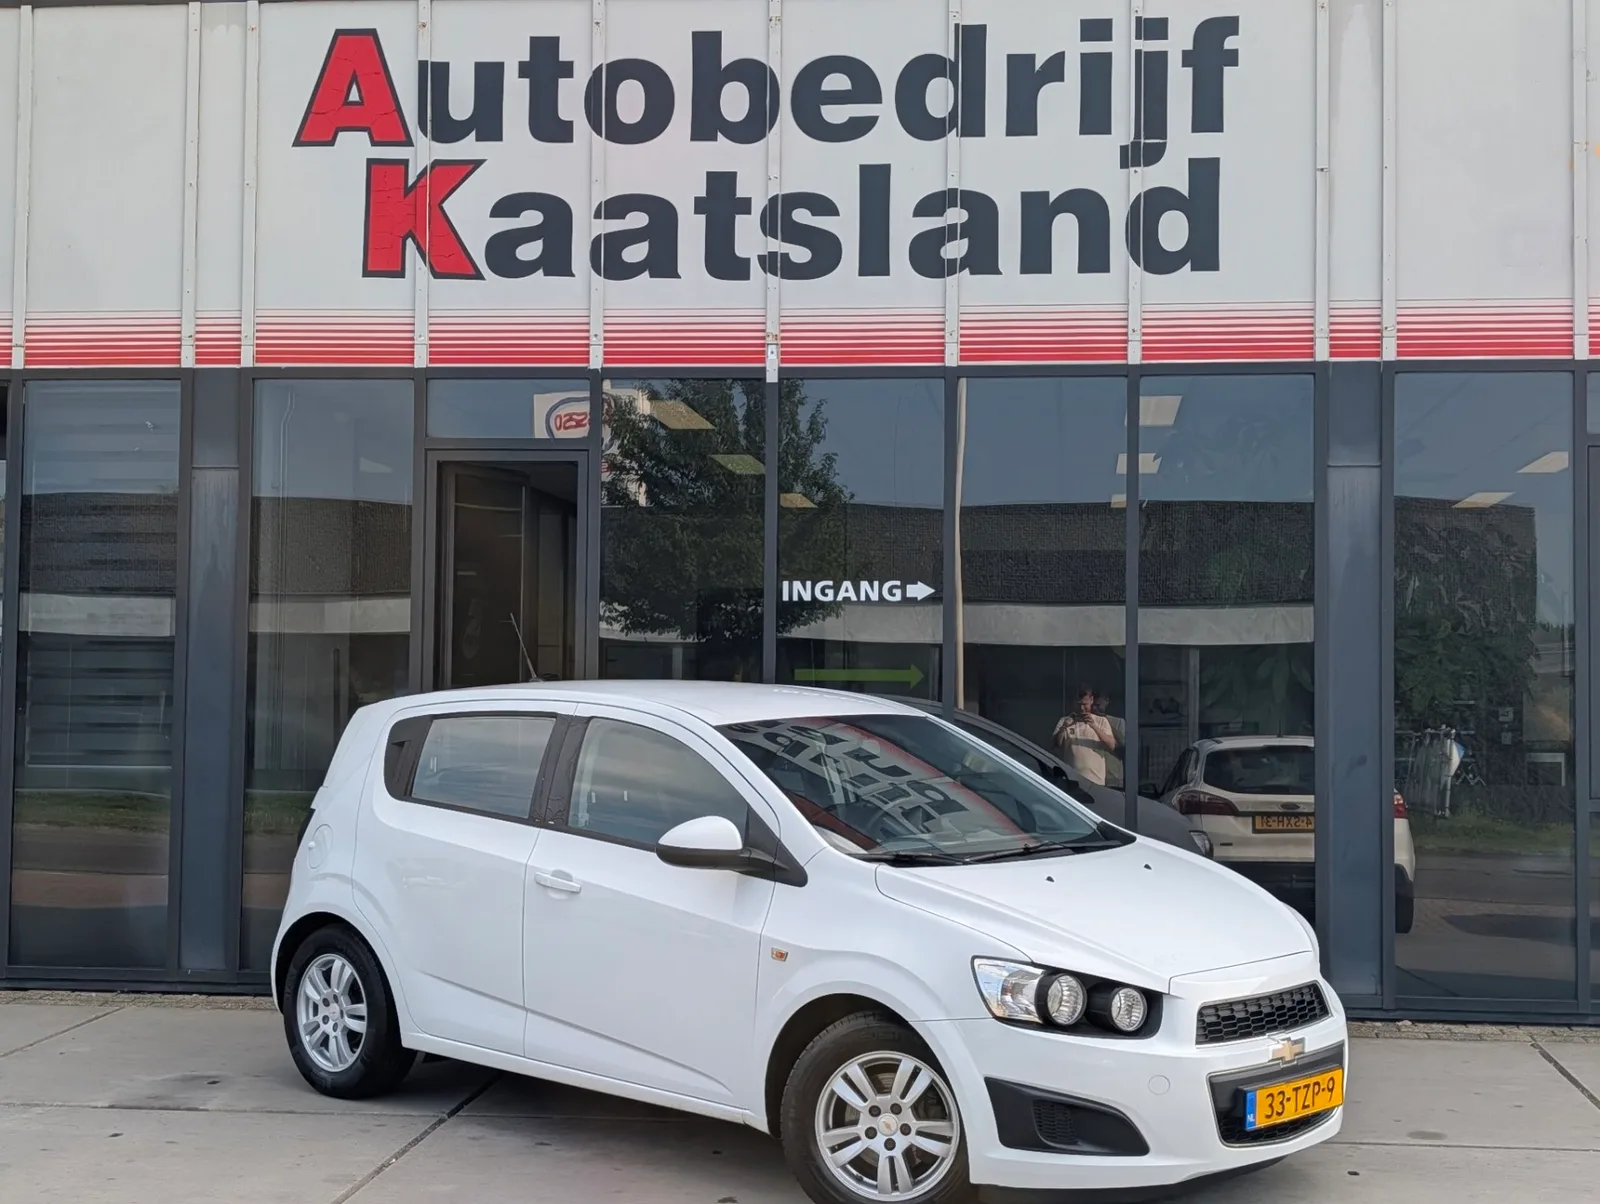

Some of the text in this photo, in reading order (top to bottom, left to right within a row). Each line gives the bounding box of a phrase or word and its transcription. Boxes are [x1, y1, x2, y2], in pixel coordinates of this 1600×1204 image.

[292, 15, 1240, 169] Autobedrijf
[362, 157, 1220, 281] Kaatsland
[781, 580, 902, 602] INGANG
[1247, 1114, 1255, 1122] NL
[1264, 1077, 1335, 1119] 33-TZP-9
